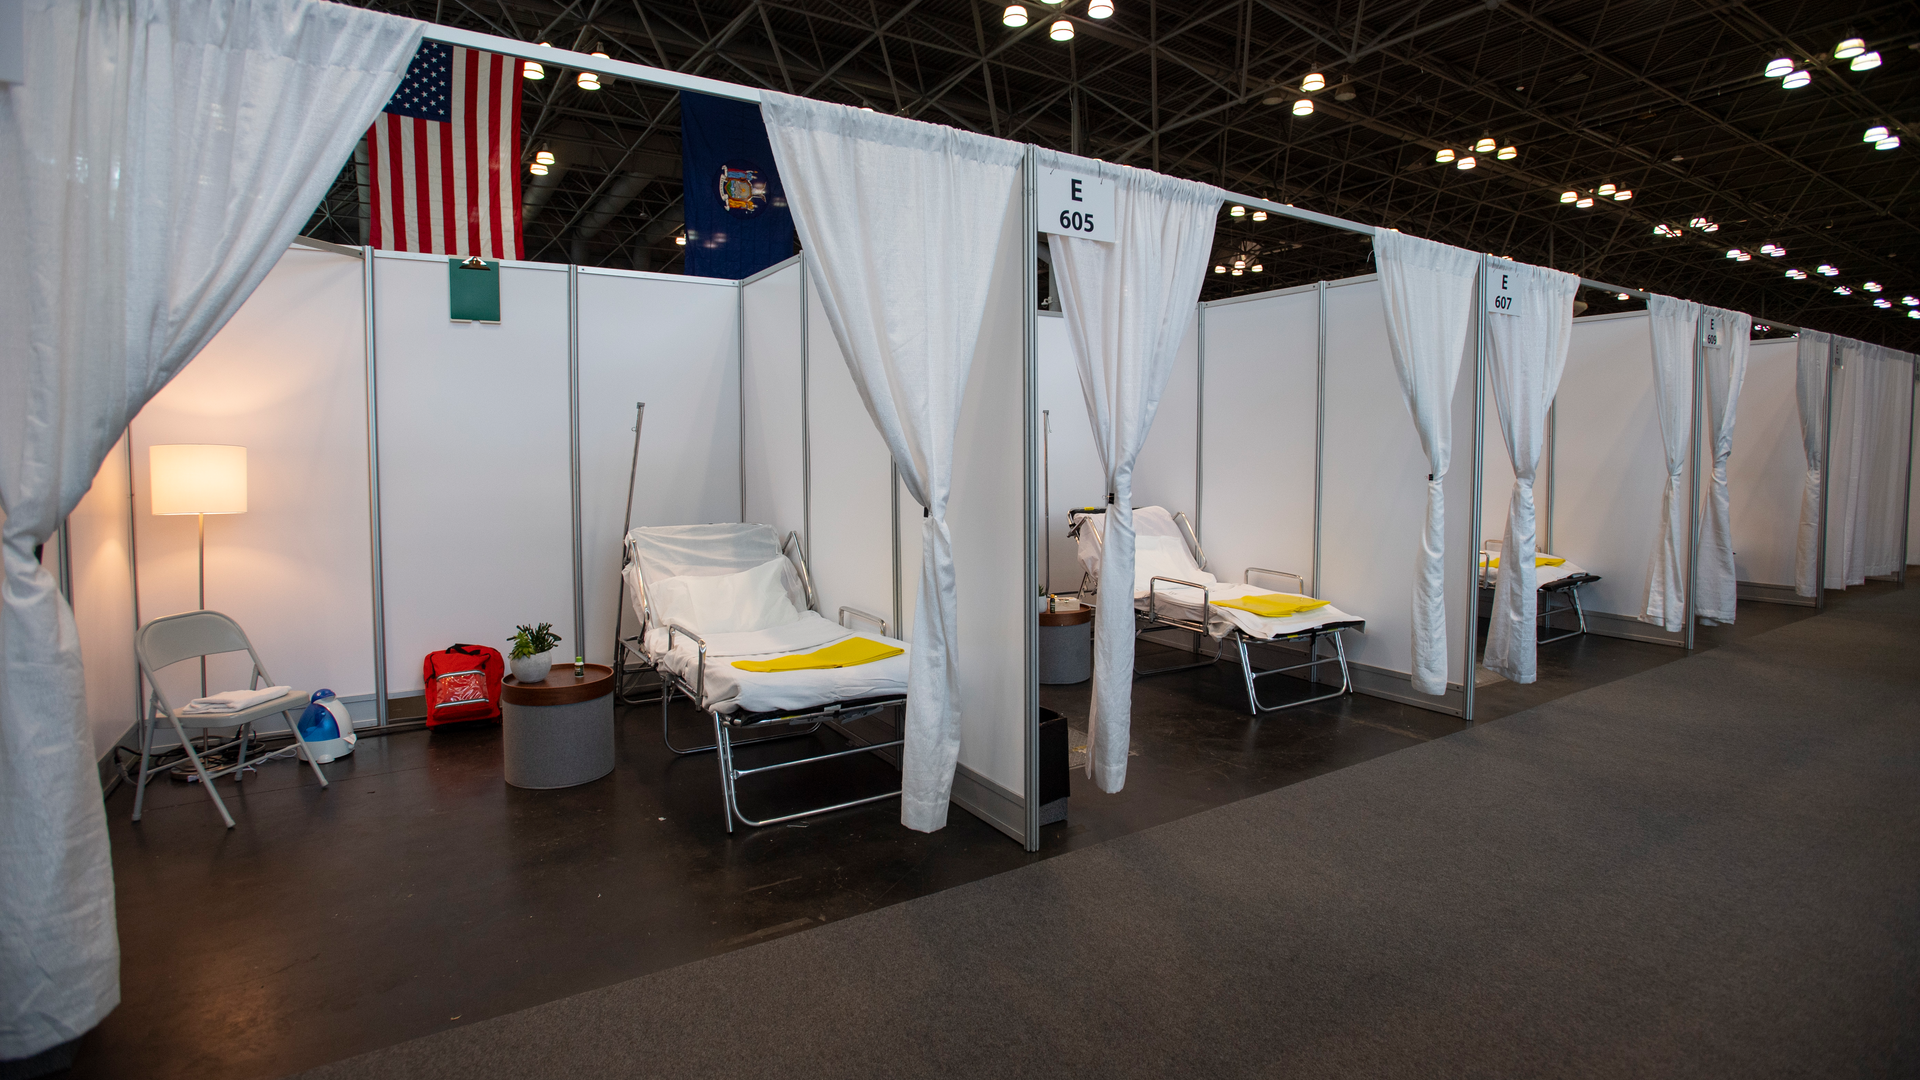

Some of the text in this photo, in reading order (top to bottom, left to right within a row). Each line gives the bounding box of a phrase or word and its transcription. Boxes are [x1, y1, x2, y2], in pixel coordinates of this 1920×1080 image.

[1071, 178, 1083, 202] E
[1059, 209, 1094, 233] 605
[1501, 274, 1508, 290] E
[1494, 295, 1512, 310] 607
[1710, 318, 1715, 330] E
[1707, 334, 1717, 345] 609
